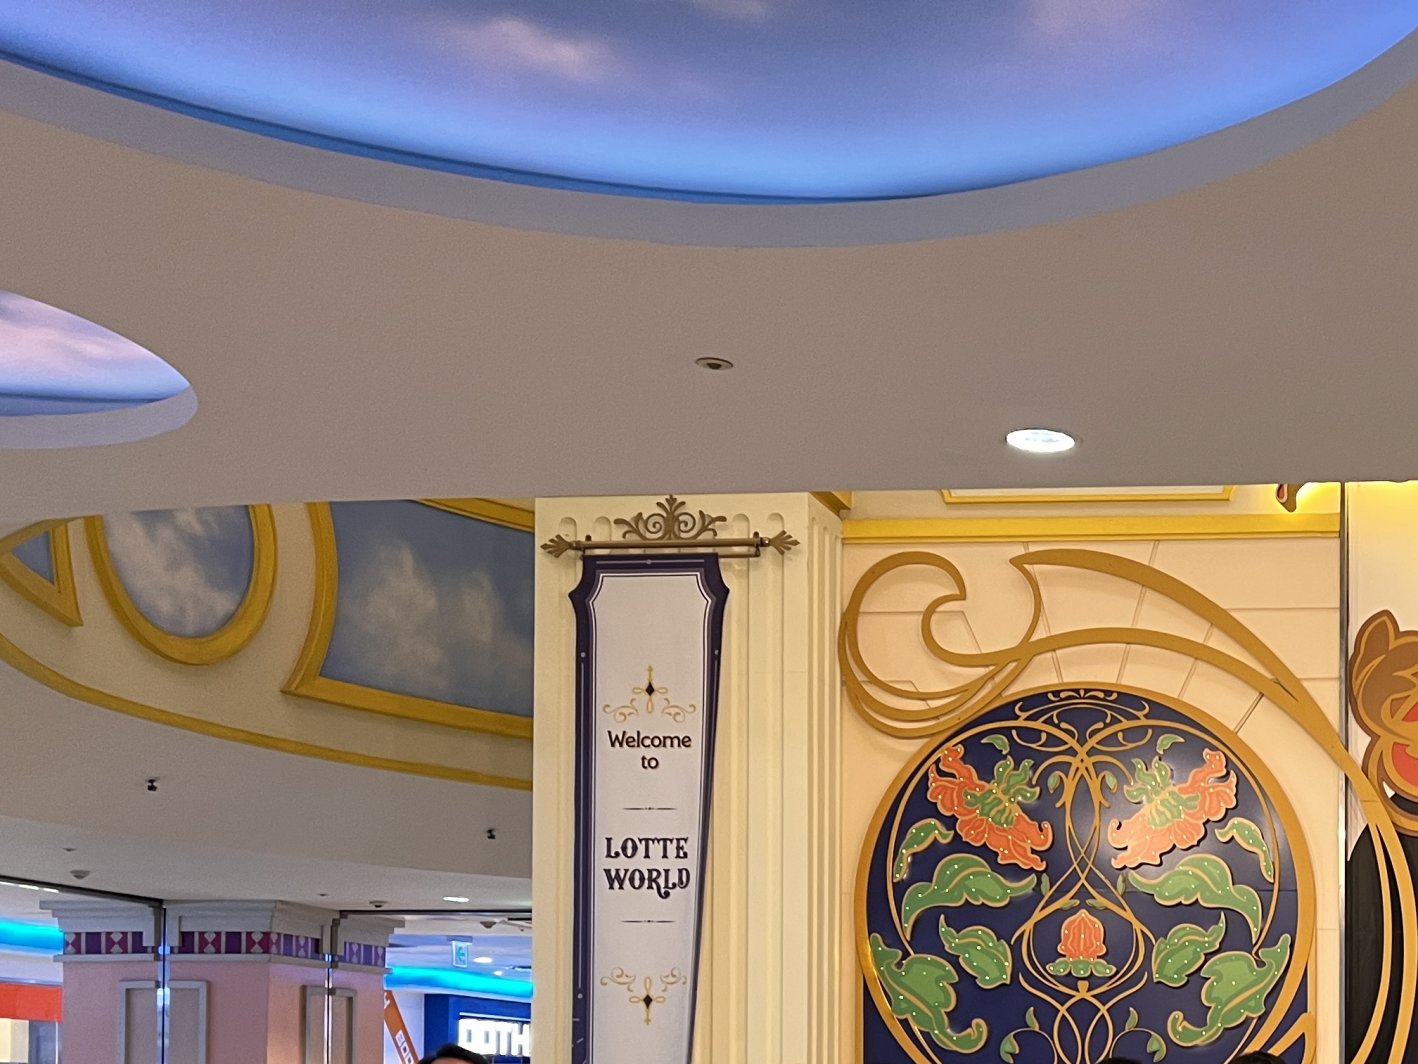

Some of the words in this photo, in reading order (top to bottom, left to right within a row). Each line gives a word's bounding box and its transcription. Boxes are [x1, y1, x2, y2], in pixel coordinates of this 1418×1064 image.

[607, 730, 692, 748] Welcome
[641, 755, 659, 769] to
[605, 837, 689, 859] LOTTE
[603, 868, 691, 899] WORLD
